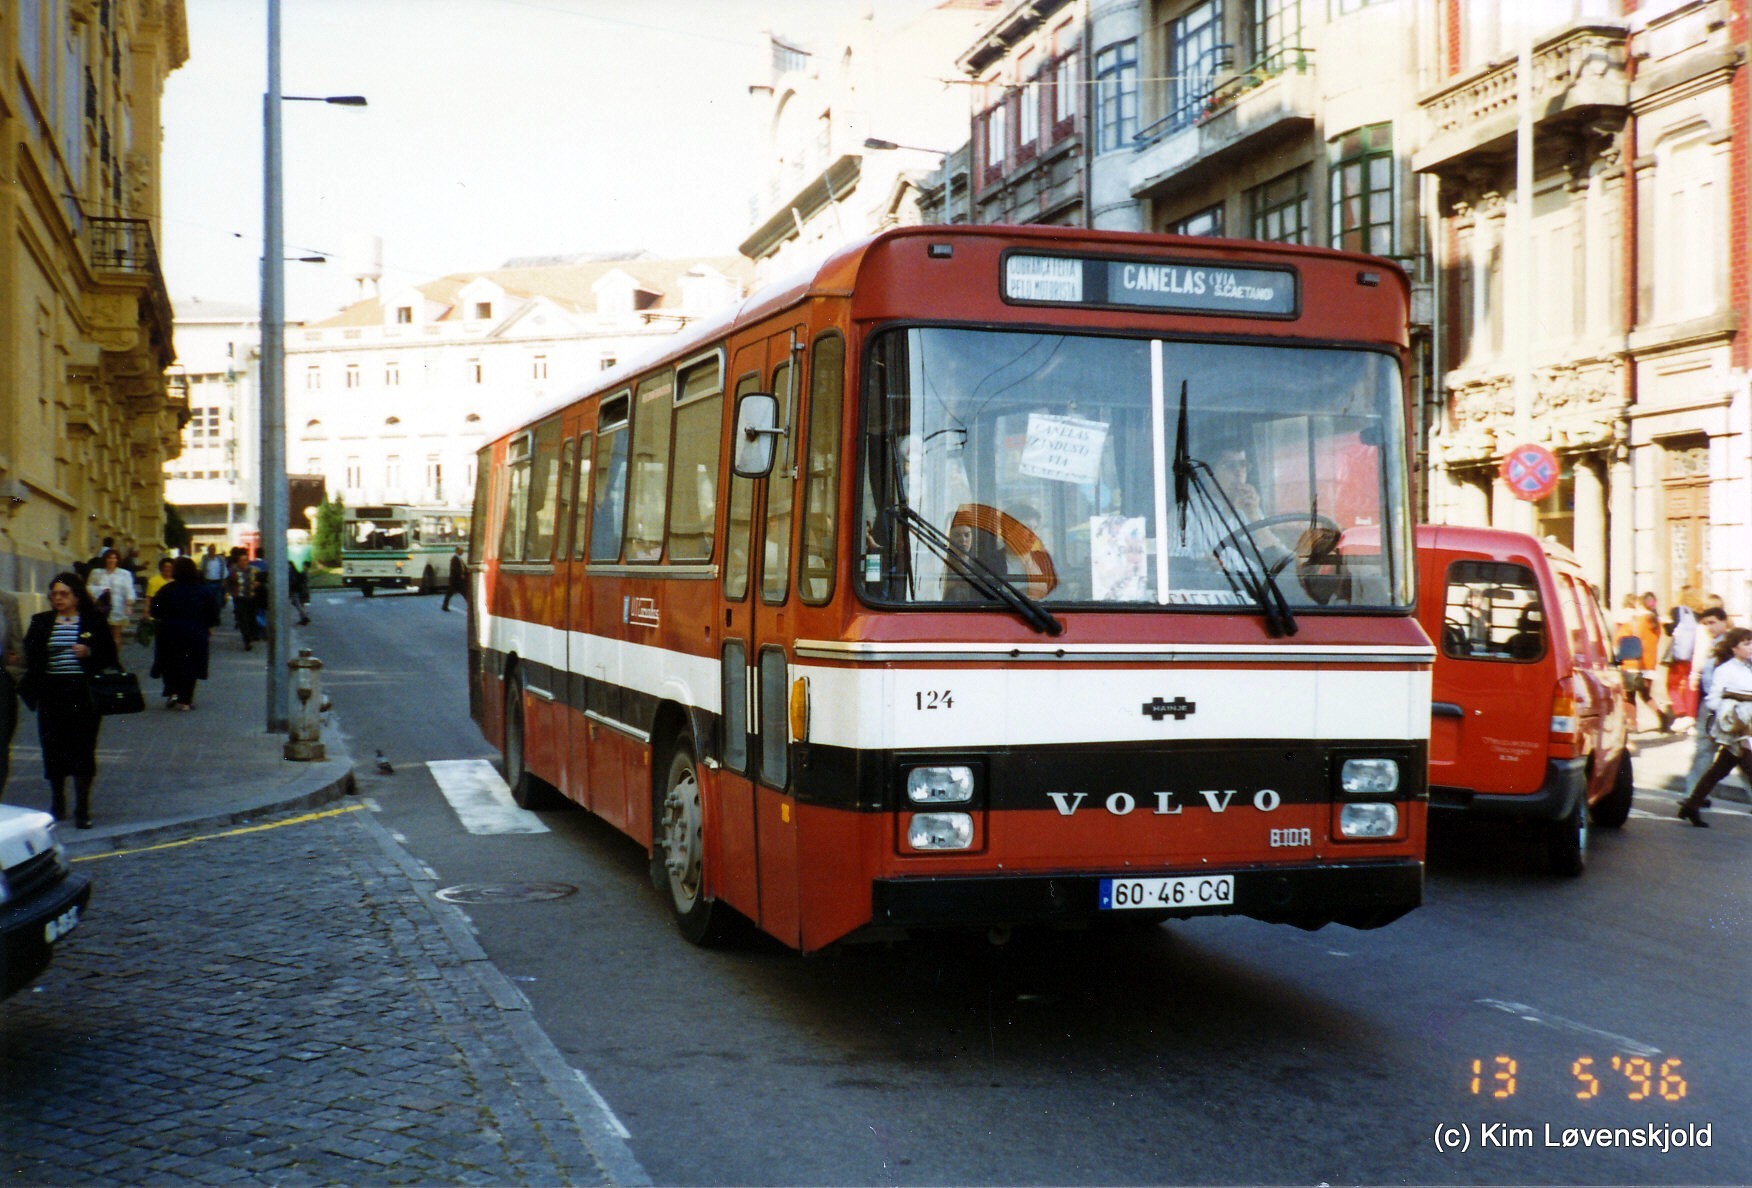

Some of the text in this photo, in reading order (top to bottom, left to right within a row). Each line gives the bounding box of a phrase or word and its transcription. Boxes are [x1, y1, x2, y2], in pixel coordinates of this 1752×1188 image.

[1123, 264, 1206, 295] CANELAS
[916, 690, 956, 711] 124
[1047, 788, 1281, 816] VOLVO
